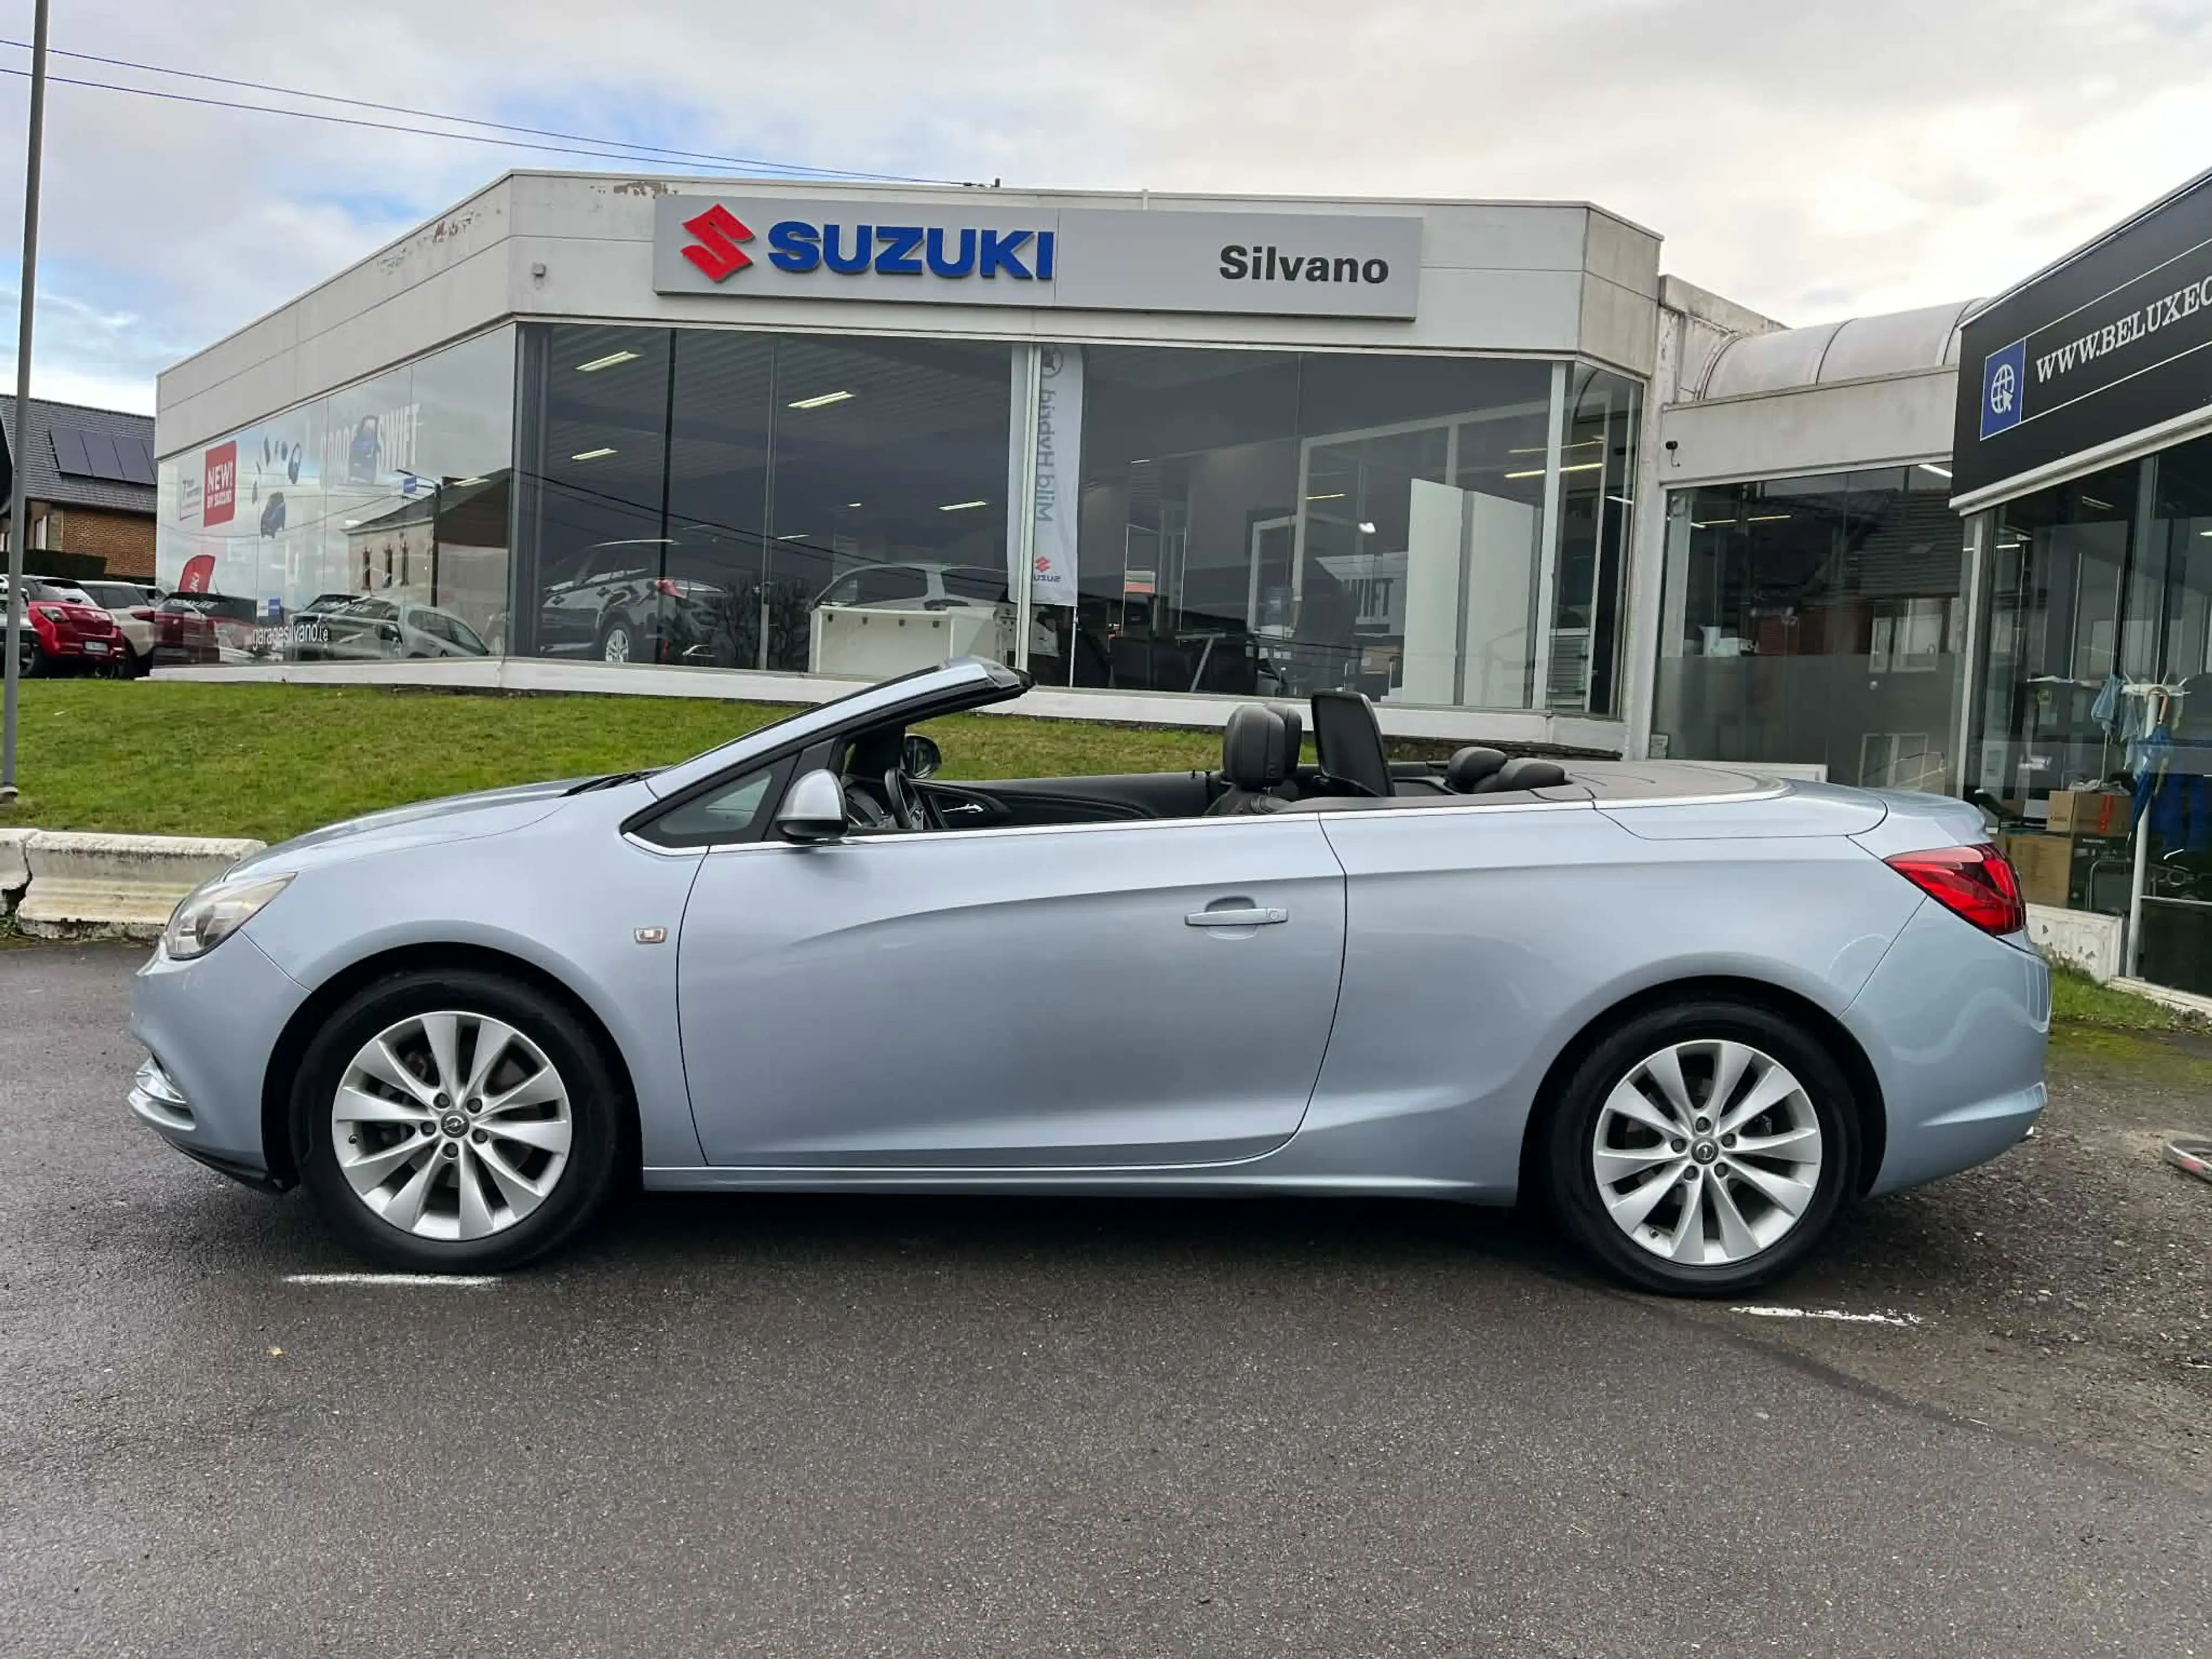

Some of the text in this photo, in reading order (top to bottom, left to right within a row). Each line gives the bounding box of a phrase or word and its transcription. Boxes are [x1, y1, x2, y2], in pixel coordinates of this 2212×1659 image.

[768, 220, 1056, 279] SUZUKI
[1219, 245, 1389, 284] Silvano
[207, 459, 233, 494] NEW!
